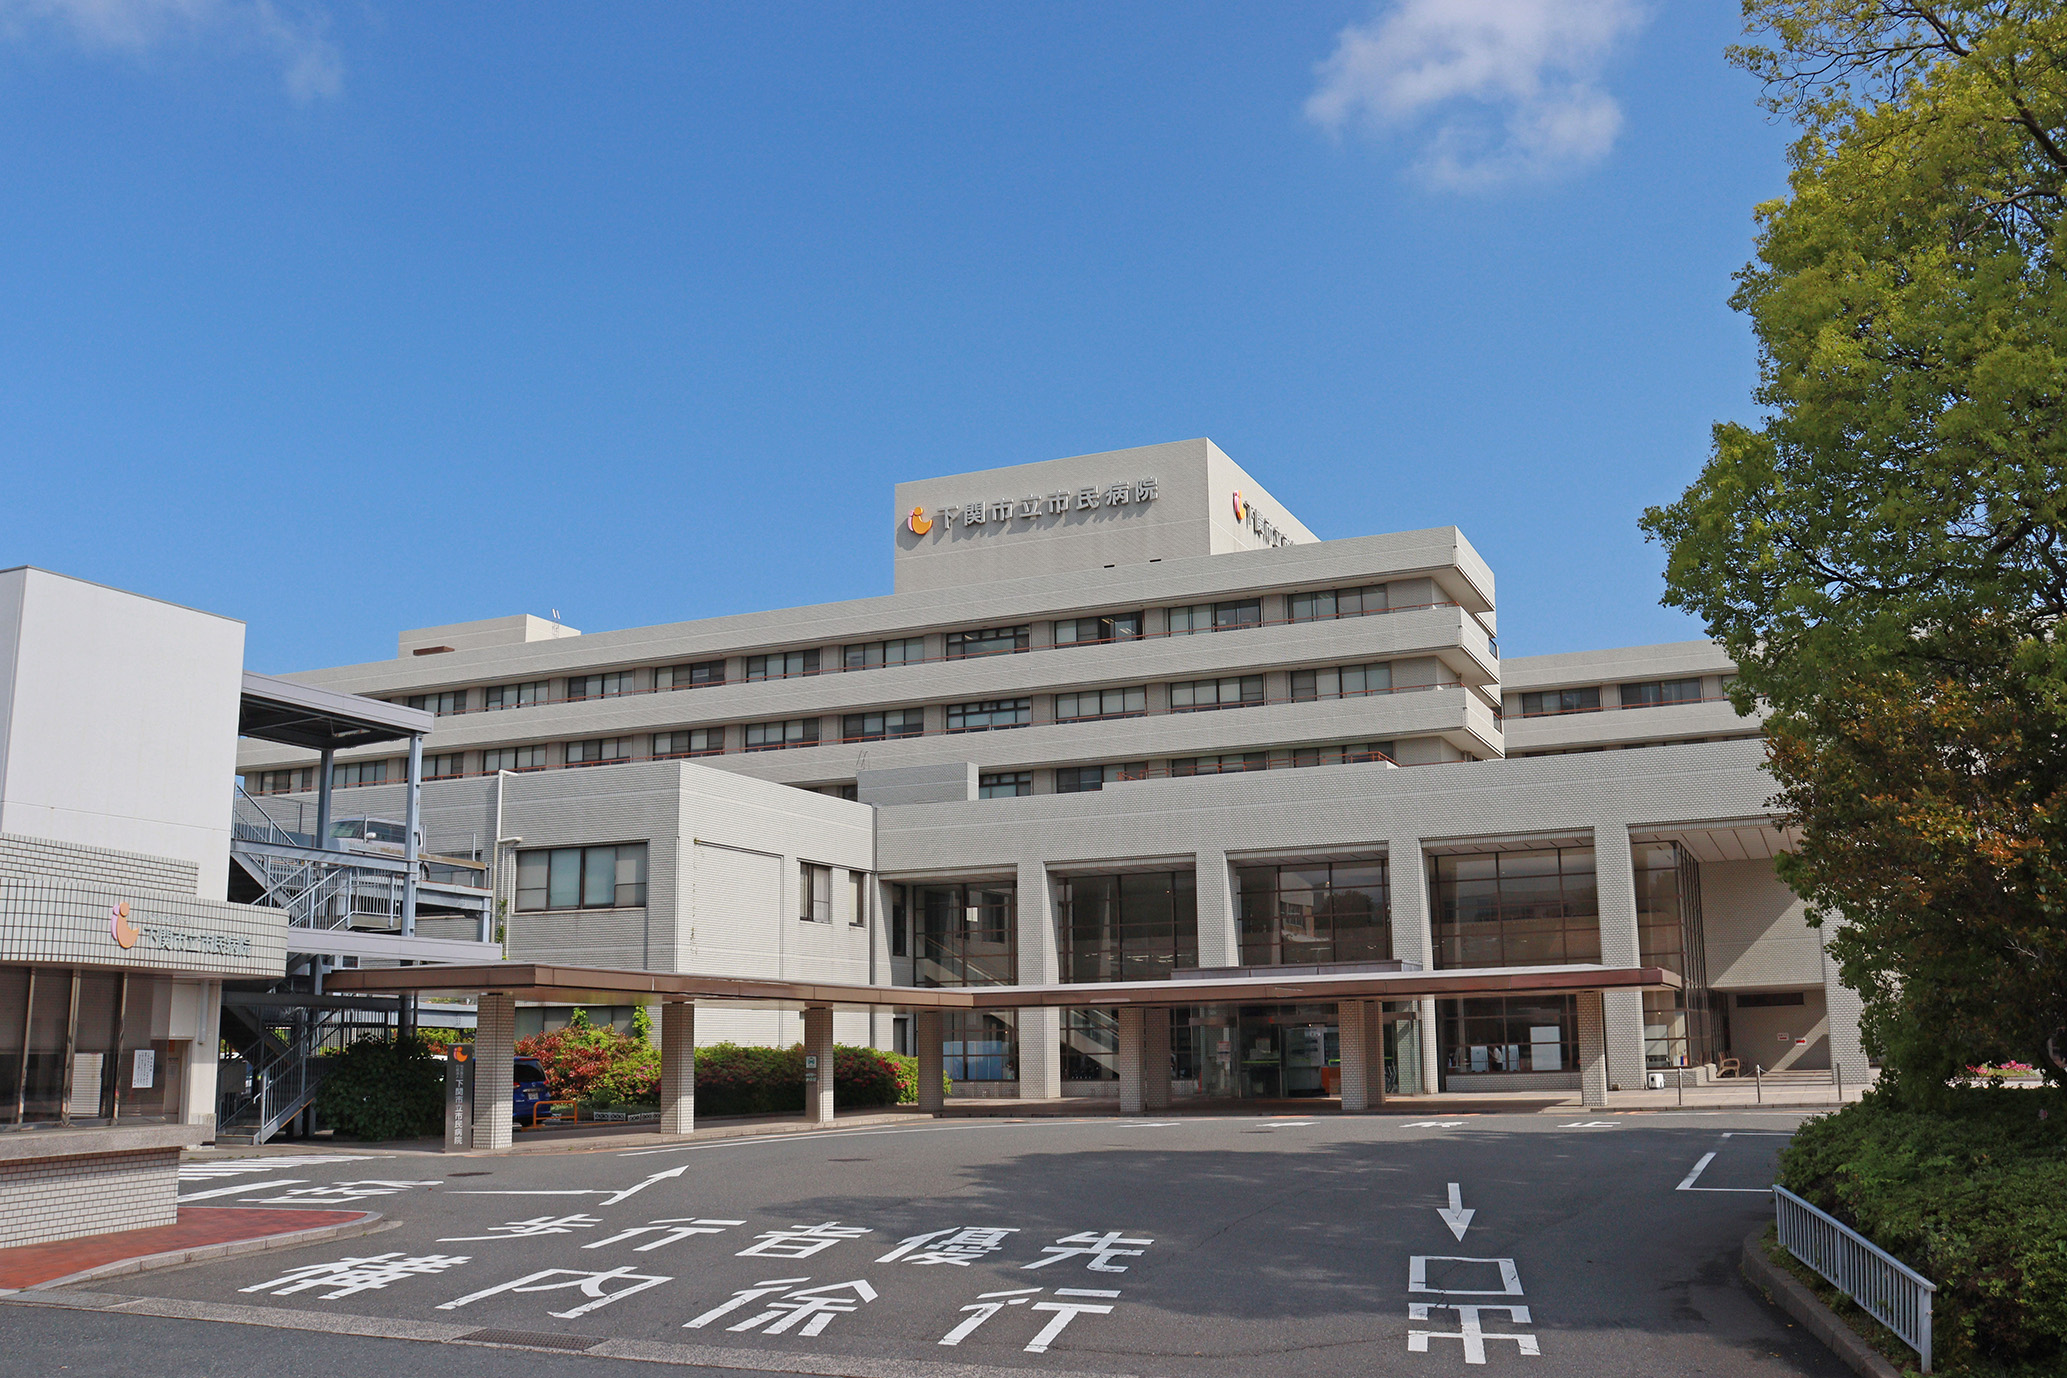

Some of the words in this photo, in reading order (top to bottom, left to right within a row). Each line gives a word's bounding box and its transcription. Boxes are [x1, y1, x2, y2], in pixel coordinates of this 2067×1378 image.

[937, 476, 1159, 529] 下関市立市民病院
[144, 927, 251, 958] 下関市立市民病院
[453, 1079, 464, 1145] 下関市立市民病院
[436, 1213, 1155, 1273] 歩行者優先
[238, 1252, 1122, 1353] 構内徐行
